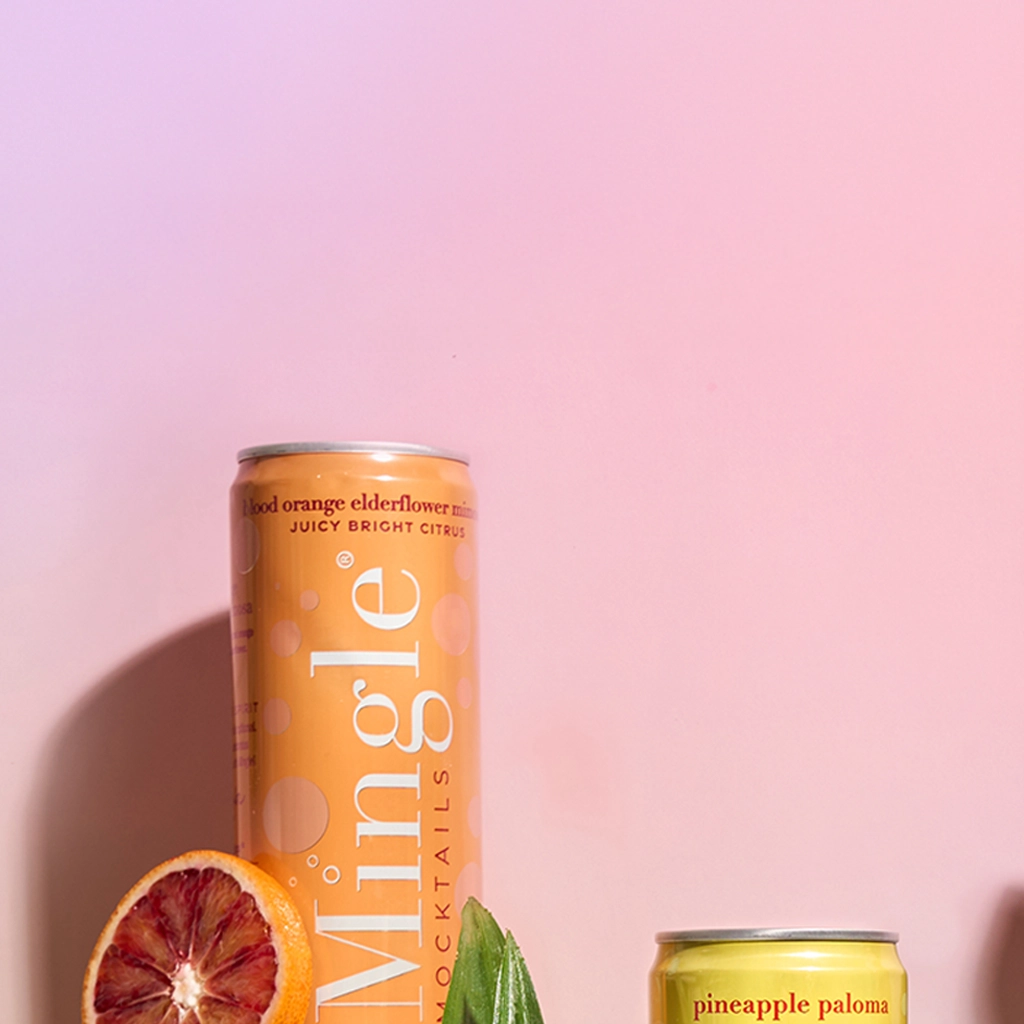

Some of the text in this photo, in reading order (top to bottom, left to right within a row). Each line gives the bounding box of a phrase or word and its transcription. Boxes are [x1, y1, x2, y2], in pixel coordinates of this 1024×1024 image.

[282, 499, 346, 517] orange
[350, 493, 449, 515] elderflower
[290, 520, 465, 538] JUICY BRIGHT CITRUS
[693, 992, 889, 1021] pineapple paloma
